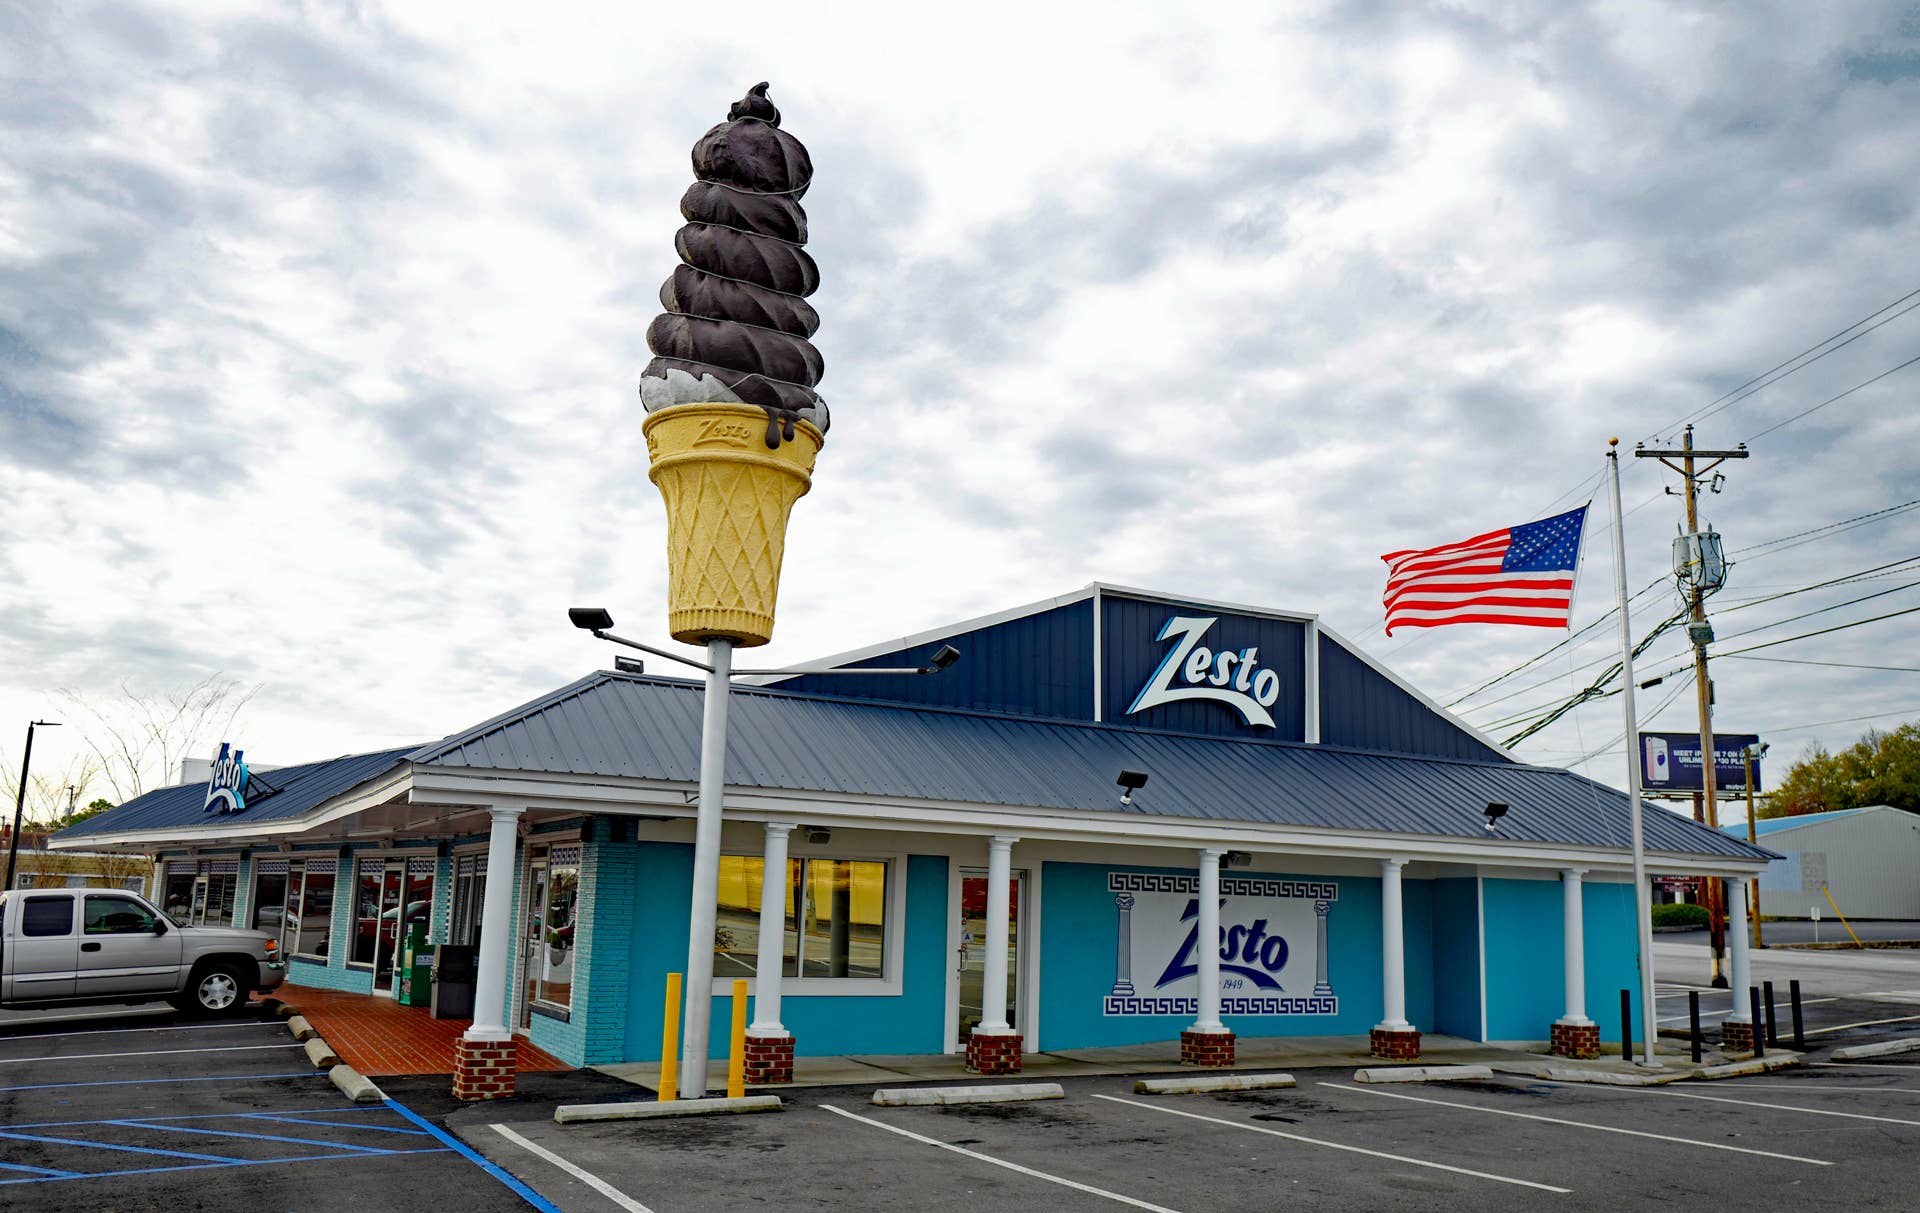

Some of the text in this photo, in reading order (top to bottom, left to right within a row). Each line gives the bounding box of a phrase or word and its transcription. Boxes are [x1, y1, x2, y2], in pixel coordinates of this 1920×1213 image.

[692, 418, 750, 448] Zesto
[1125, 616, 1279, 728] Zesto
[203, 743, 246, 813] Zesto
[1673, 749, 1693, 757] MEET
[1154, 898, 1289, 992] Zsto
[1223, 979, 1243, 989] 1949
